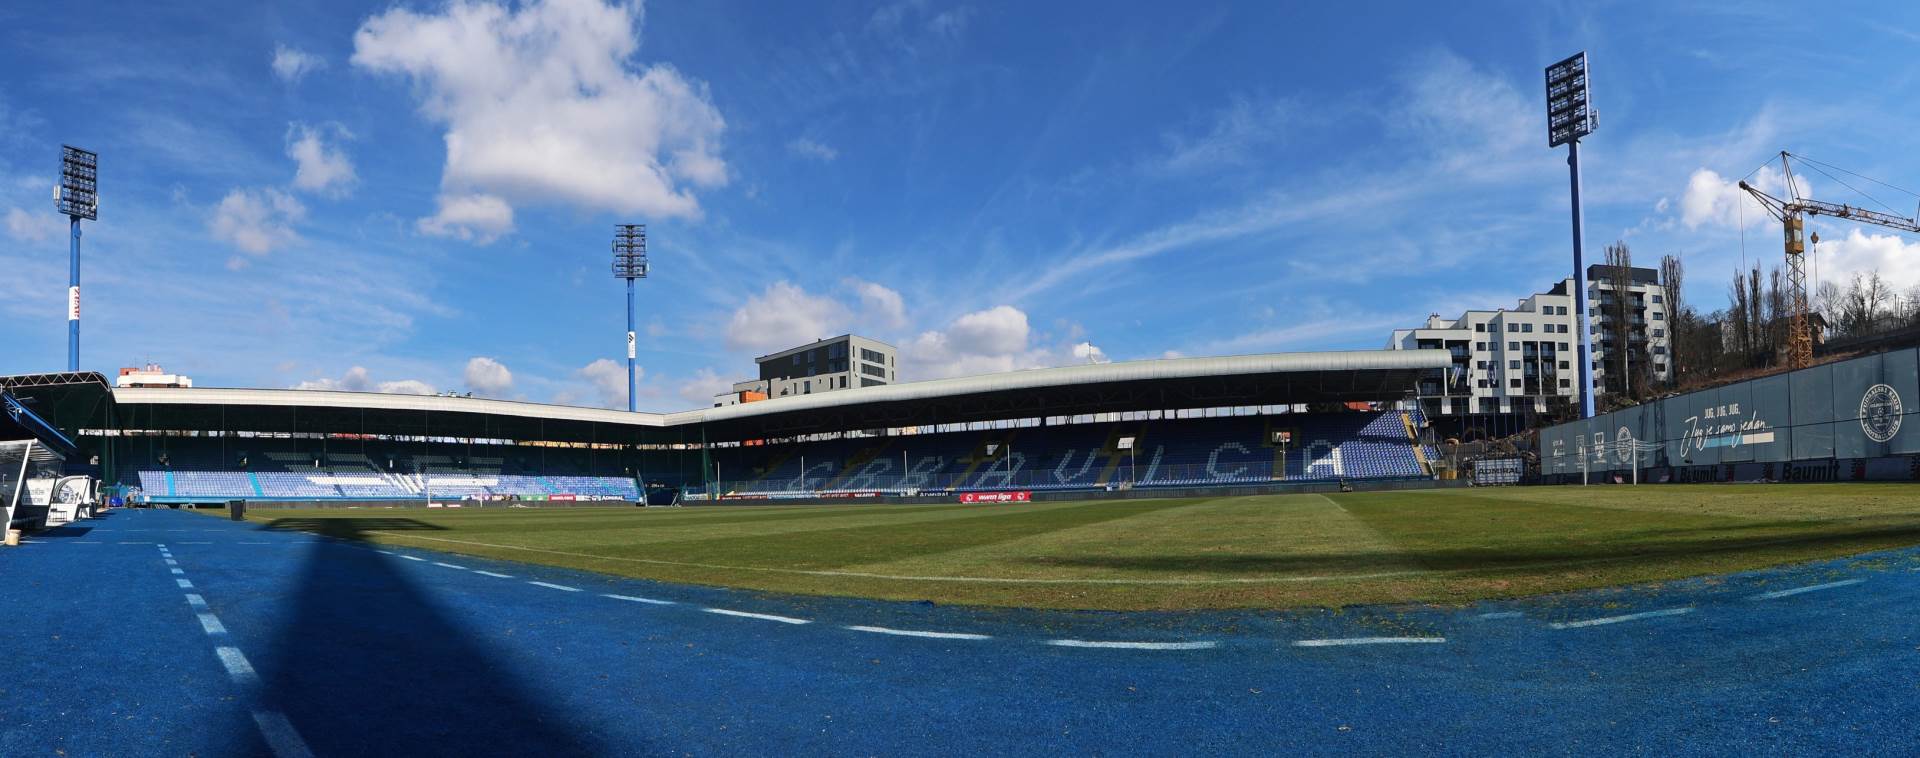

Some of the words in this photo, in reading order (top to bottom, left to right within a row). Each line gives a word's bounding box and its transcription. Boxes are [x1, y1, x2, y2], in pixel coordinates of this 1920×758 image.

[1704, 407, 1715, 419] JUG,
[1728, 403, 1741, 415] JUG,
[1478, 467, 1522, 475] ADMIRAL
[1782, 459, 1841, 480] Baumit
